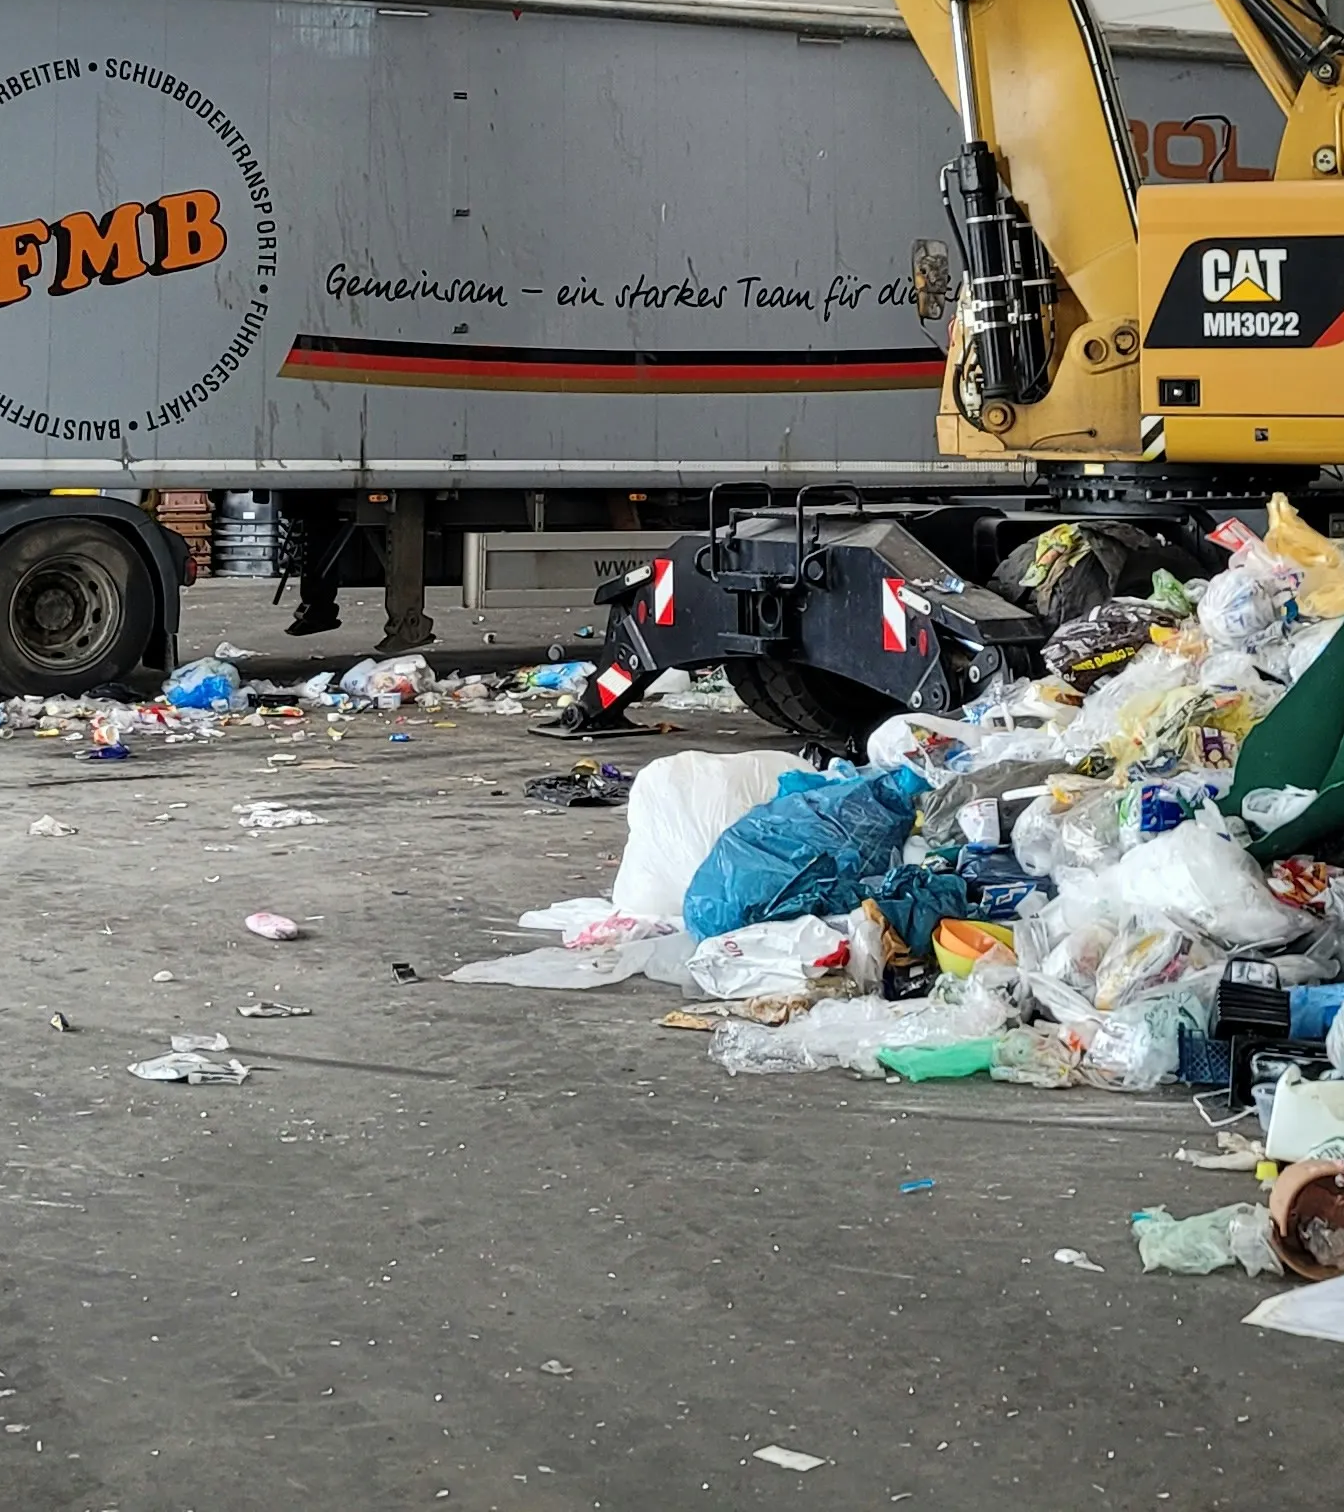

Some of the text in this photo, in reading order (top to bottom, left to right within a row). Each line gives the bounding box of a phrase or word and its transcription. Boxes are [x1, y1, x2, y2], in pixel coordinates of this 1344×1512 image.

[104, 58, 278, 278] SCHUBBODENTRANSPORTE
[326, 263, 508, 308] Gemeinsam
[557, 275, 605, 309] ein
[615, 273, 729, 312] starkes
[738, 276, 815, 312] Team
[823, 274, 872, 323] für
[1202, 248, 1288, 302] CAT
[1203, 312, 1300, 338] MH3022
[146, 298, 269, 432] FUHRGESCHÄFT
